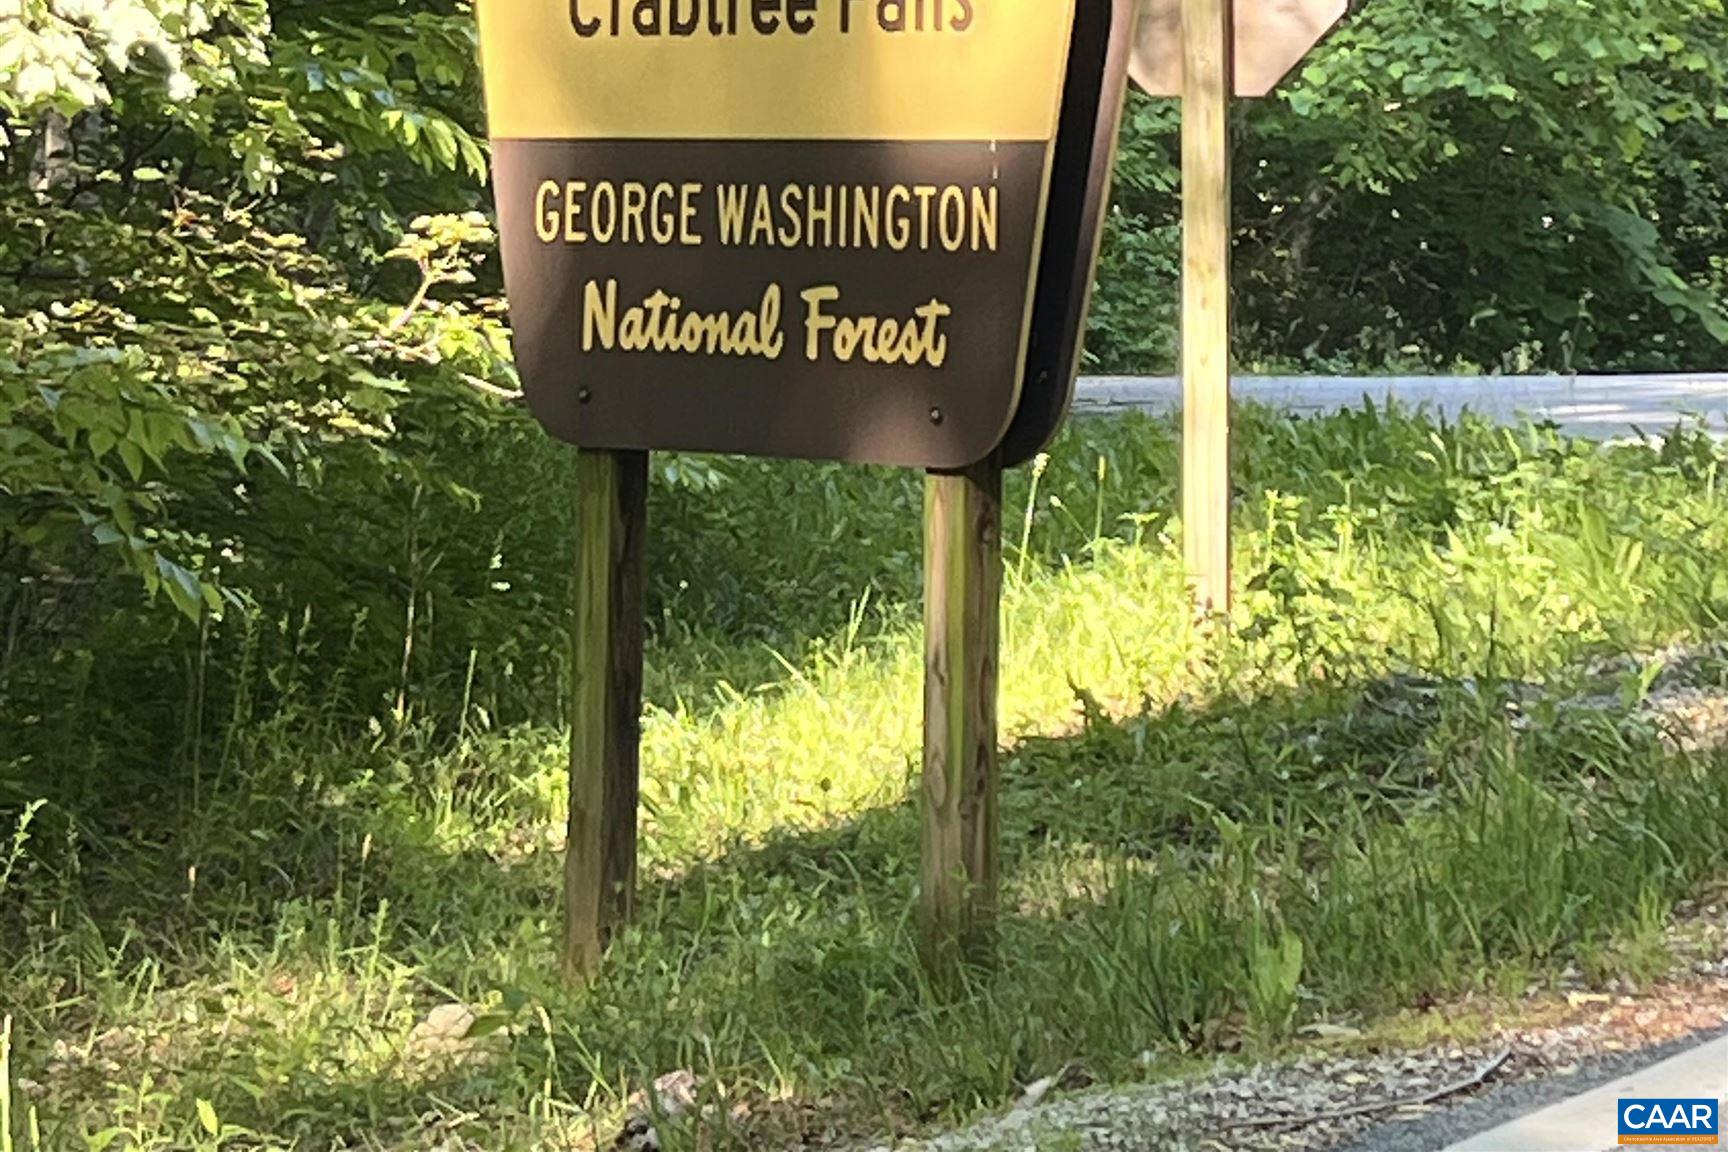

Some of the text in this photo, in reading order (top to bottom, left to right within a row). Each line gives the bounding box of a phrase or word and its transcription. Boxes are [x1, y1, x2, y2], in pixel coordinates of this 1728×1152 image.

[535, 180, 997, 252] GEORGE WASHINGTON
[583, 279, 950, 367] National Forest
